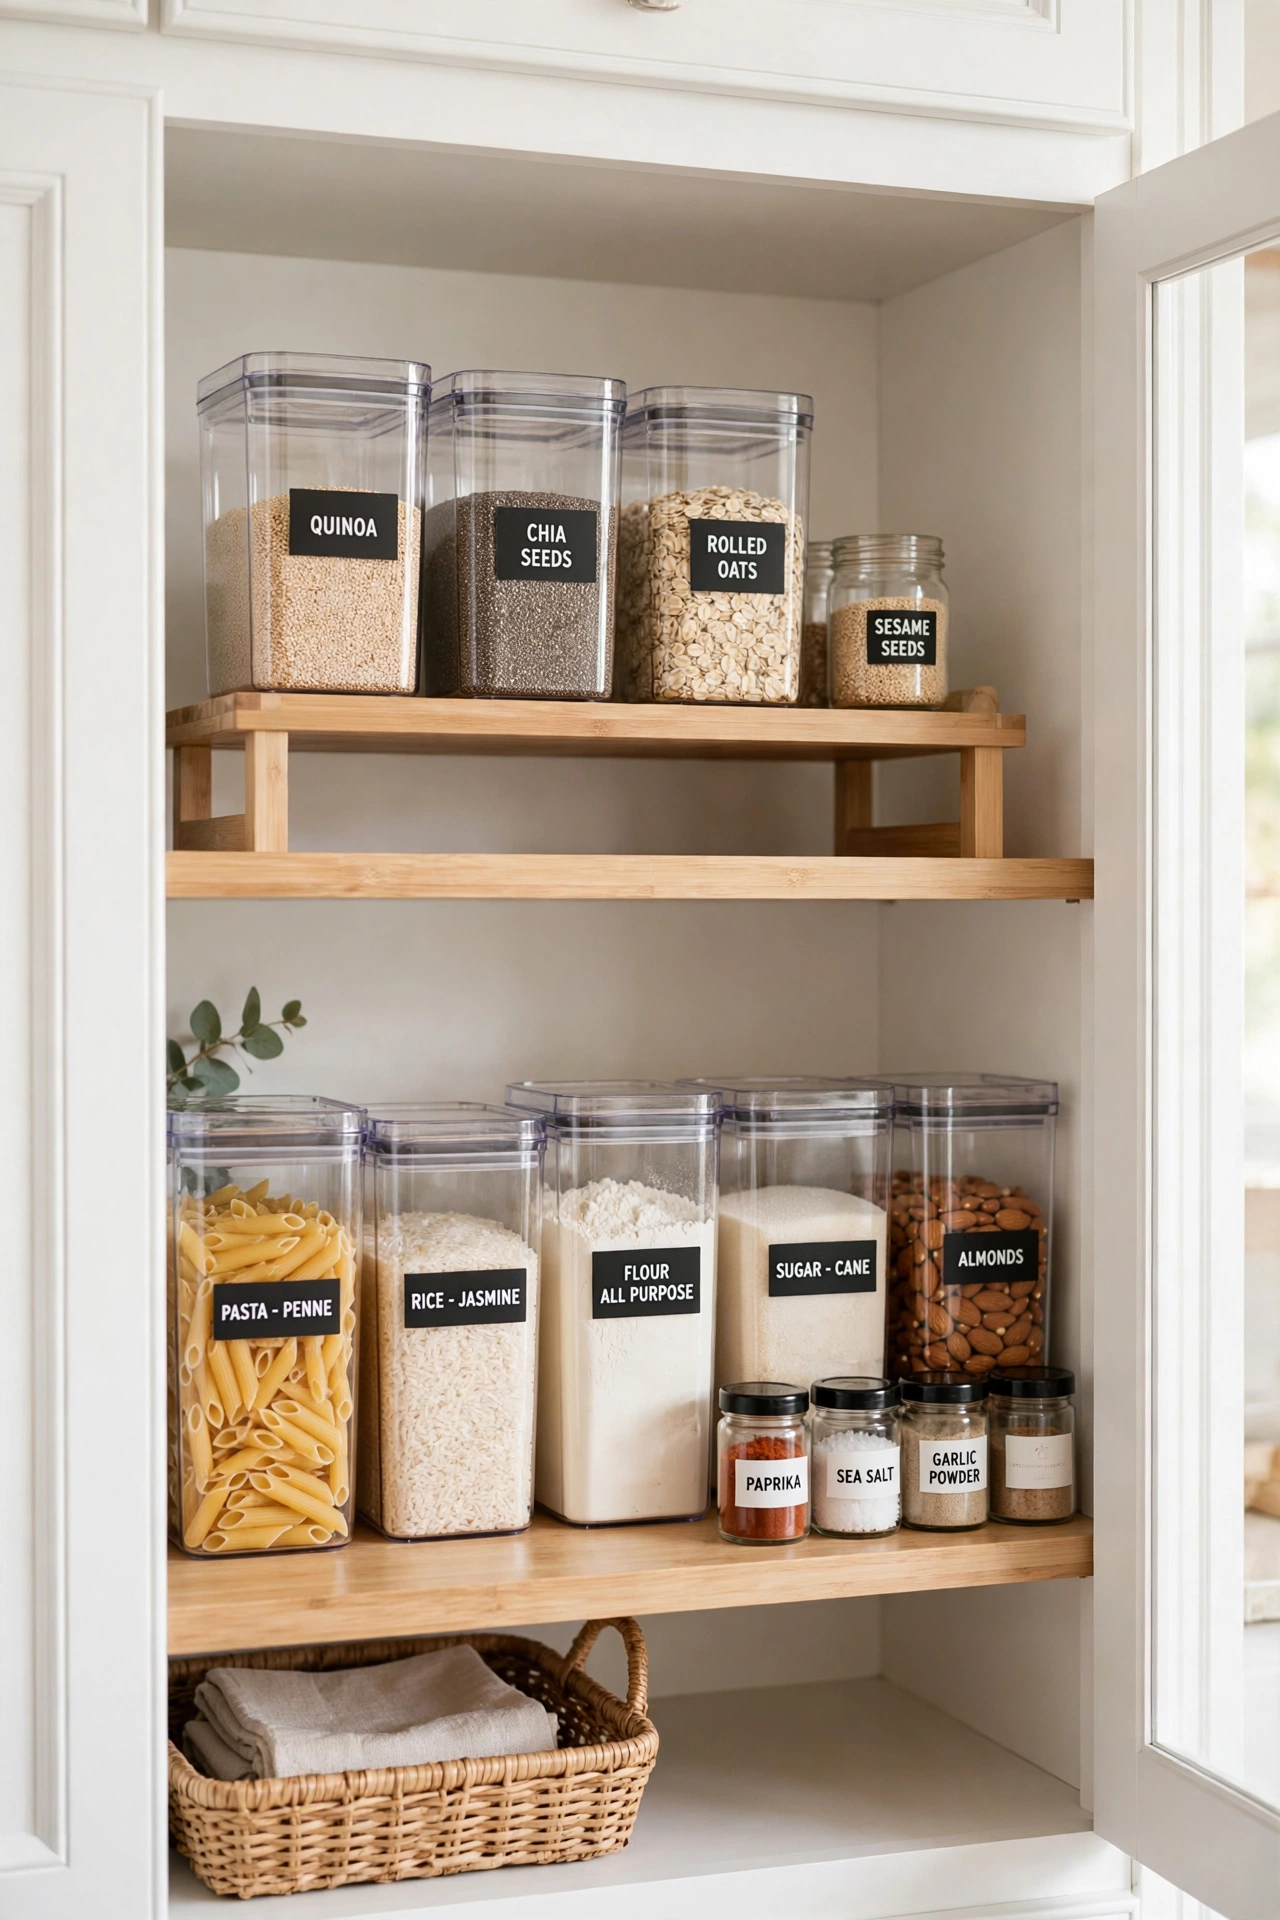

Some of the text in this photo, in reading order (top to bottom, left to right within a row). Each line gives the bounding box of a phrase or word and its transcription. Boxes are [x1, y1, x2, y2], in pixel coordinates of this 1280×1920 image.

[310, 514, 378, 538] QUINOA
[526, 523, 567, 544] CHIA
[707, 534, 767, 555] ROLLED
[520, 547, 573, 569] SEEDS
[717, 559, 758, 580] OATS
[874, 618, 931, 636] SESAME
[881, 639, 926, 658] SEEDS
[958, 1248, 1025, 1268] ALMONDS
[624, 1263, 670, 1282] FLOUR
[775, 1261, 823, 1280] SUGAR
[834, 1258, 871, 1277] CANE
[410, 1291, 445, 1311] RICE
[457, 1288, 521, 1309] JASMINE
[600, 1283, 694, 1305] ALL PURPOSE
[220, 1302, 269, 1322] PASTA
[282, 1298, 333, 1319] PENNE
[932, 1449, 978, 1467] GARLIC
[745, 1474, 802, 1492] PAPRIKA
[836, 1466, 895, 1485] SEA SALT
[928, 1468, 981, 1486] POWDER
